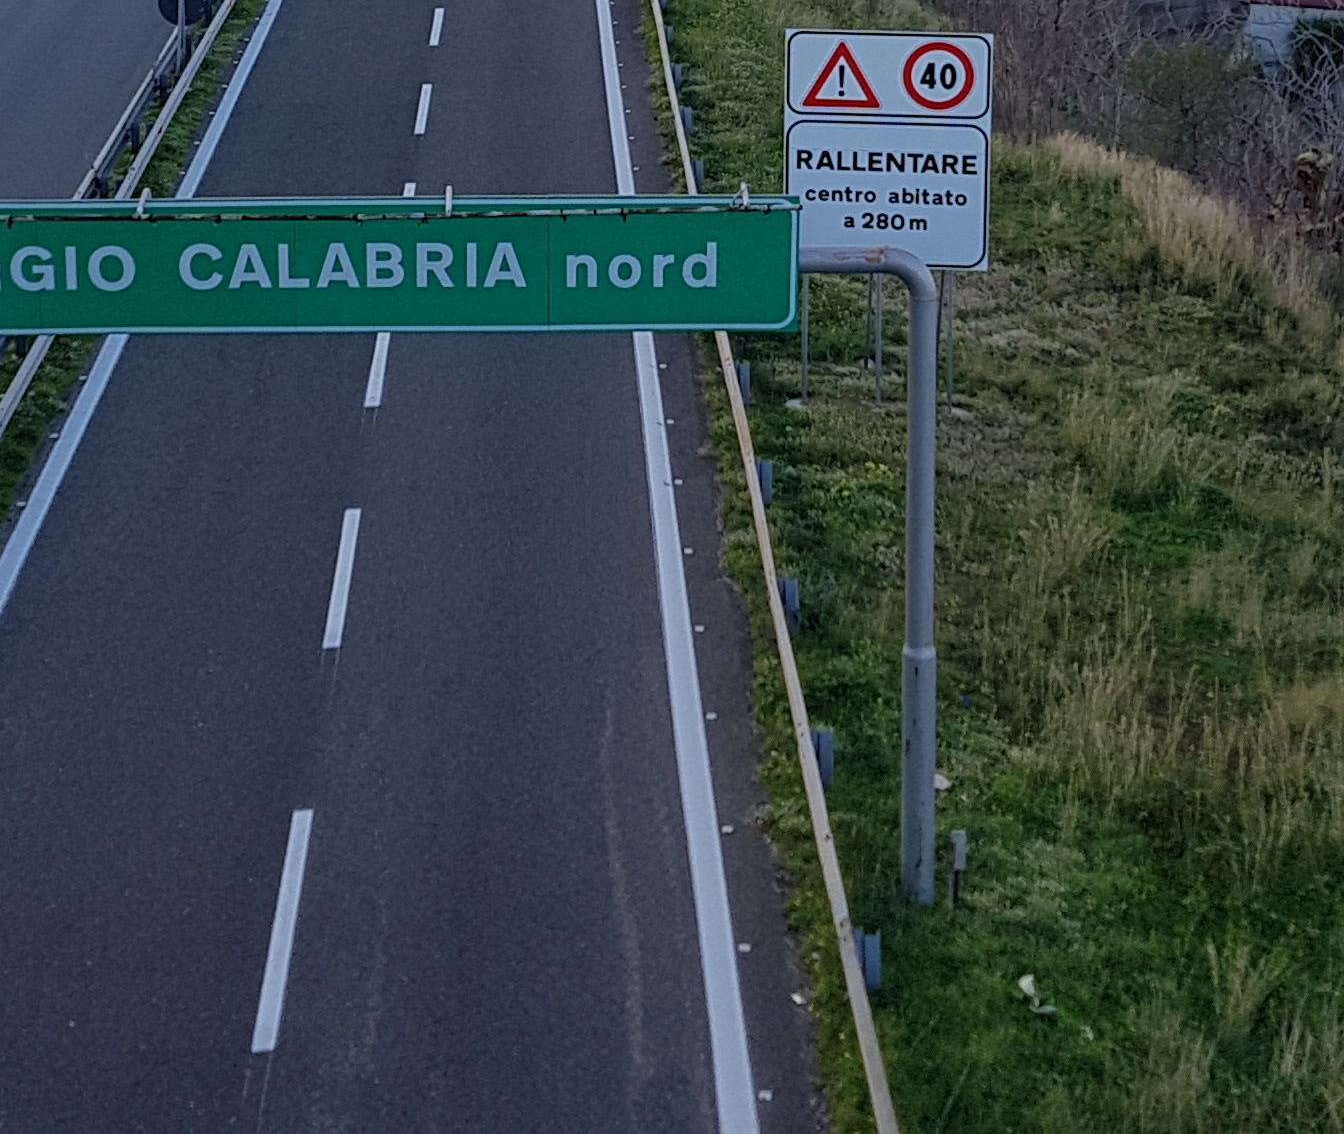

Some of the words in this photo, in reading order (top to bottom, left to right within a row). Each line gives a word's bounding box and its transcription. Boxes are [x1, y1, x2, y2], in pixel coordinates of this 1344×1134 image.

[920, 62, 957, 90] 40
[796, 149, 978, 175] RALLENTARE
[805, 186, 877, 203] centro
[888, 188, 968, 206] abitato
[843, 216, 855, 228] a
[861, 212, 905, 230] 280
[909, 217, 928, 231] m
[178, 241, 527, 290] CALABRIA
[565, 241, 718, 289] nord
